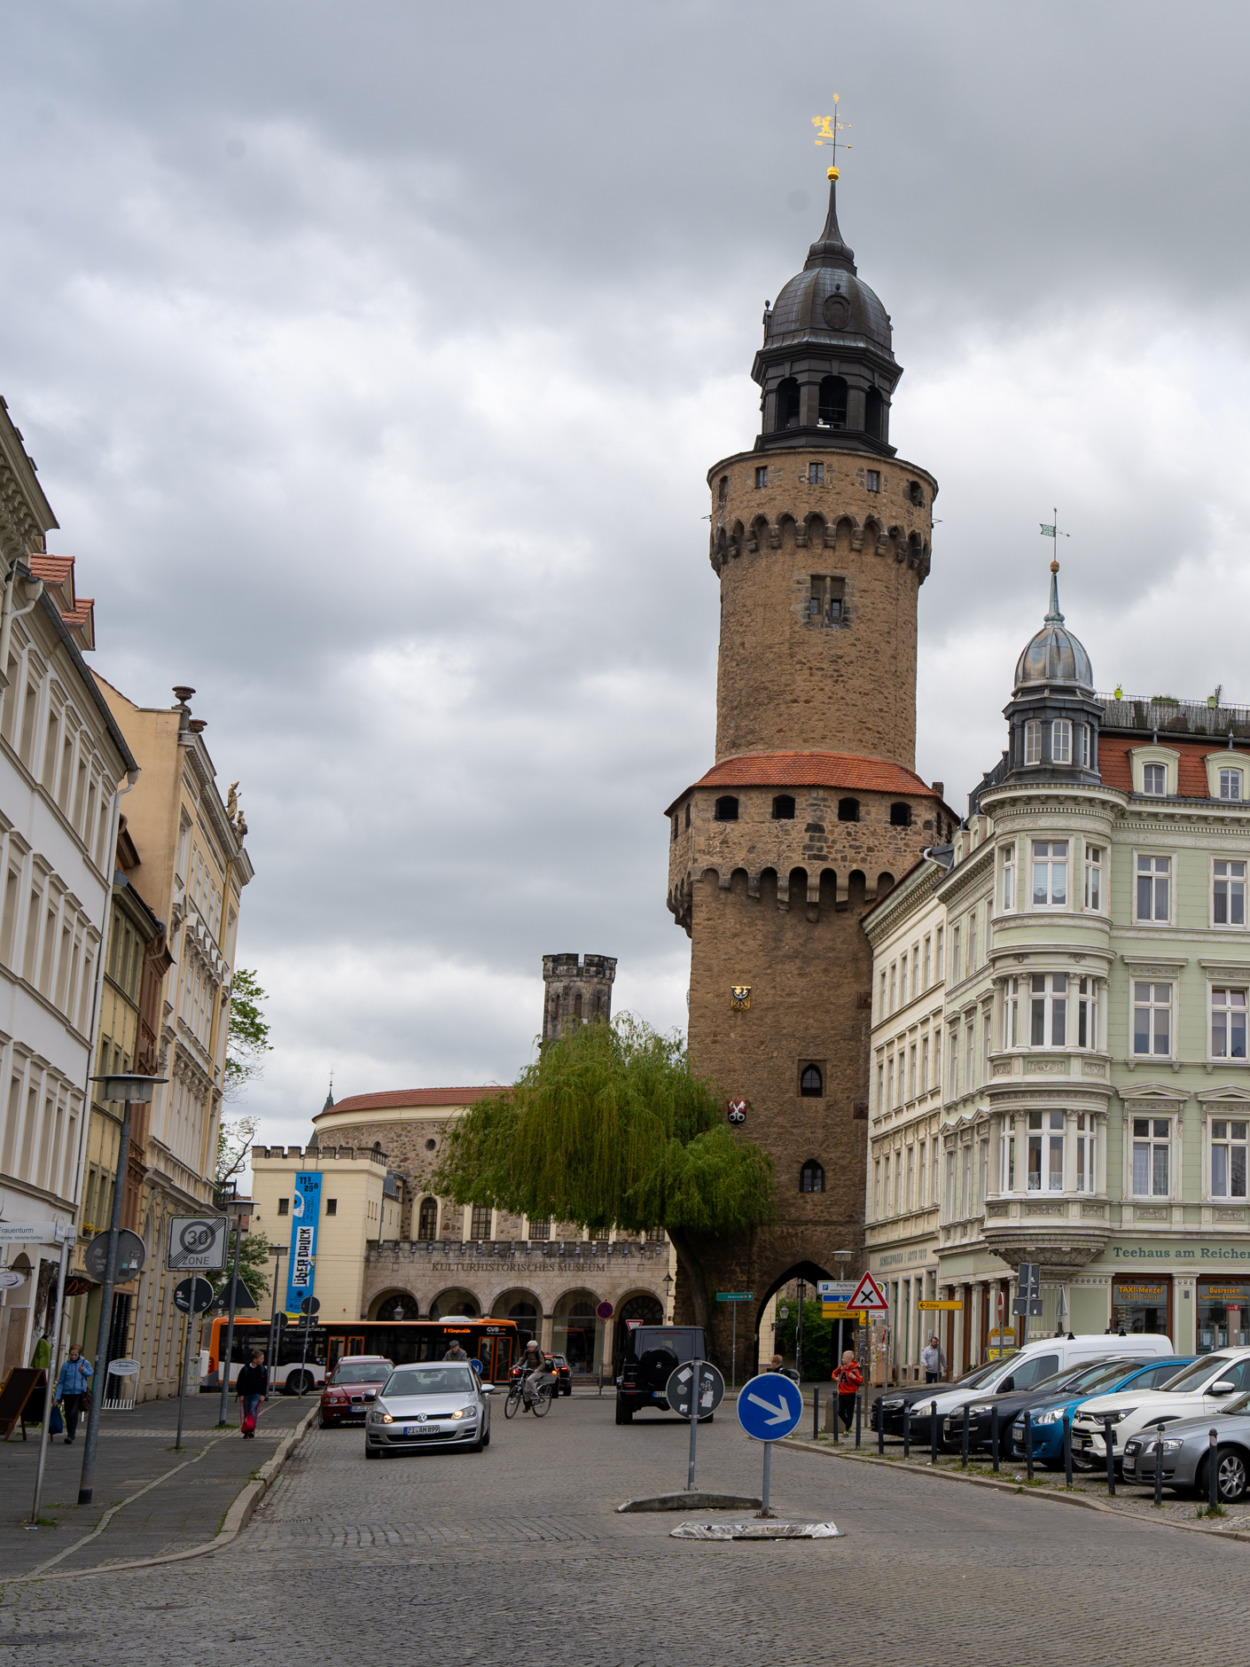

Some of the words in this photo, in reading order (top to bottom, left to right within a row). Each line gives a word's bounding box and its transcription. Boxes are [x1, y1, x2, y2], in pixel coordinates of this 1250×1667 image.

[0, 1226, 34, 1234] rauenturm
[186, 1230, 209, 1246] 30
[1113, 1246, 1171, 1258] Teehaus
[1174, 1249, 1196, 1258] am
[182, 1256, 210, 1265] ZONE
[431, 1262, 555, 1272] KULTURHISTORISCHES
[558, 1262, 606, 1272] MUSEUM
[1118, 1286, 1163, 1294] TAXI-Menzel
[1209, 1286, 1240, 1294] Busreisen
